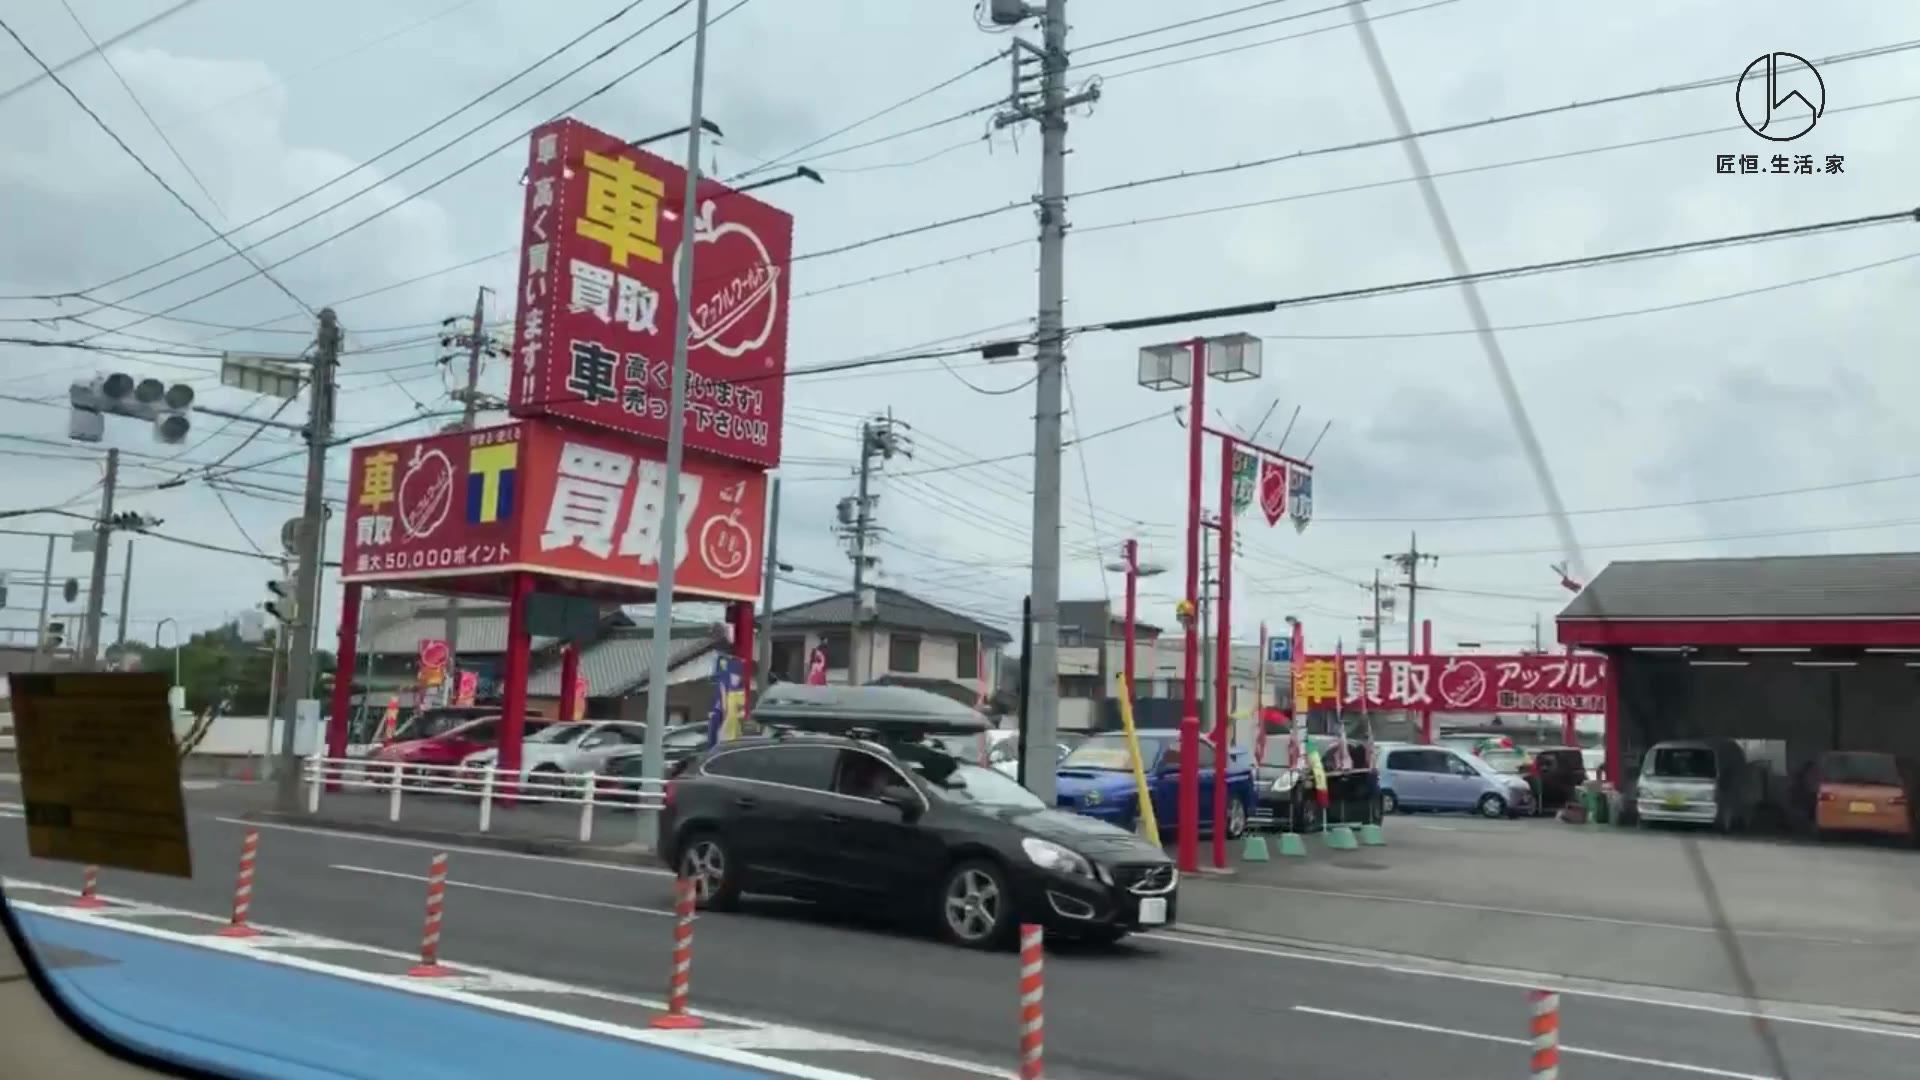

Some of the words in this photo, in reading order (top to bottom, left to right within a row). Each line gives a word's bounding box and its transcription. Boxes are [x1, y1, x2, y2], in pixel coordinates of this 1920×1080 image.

[576, 150, 664, 267] 車
[570, 258, 659, 336] 買取
[359, 450, 398, 513] 車
[357, 515, 393, 546] 買取
